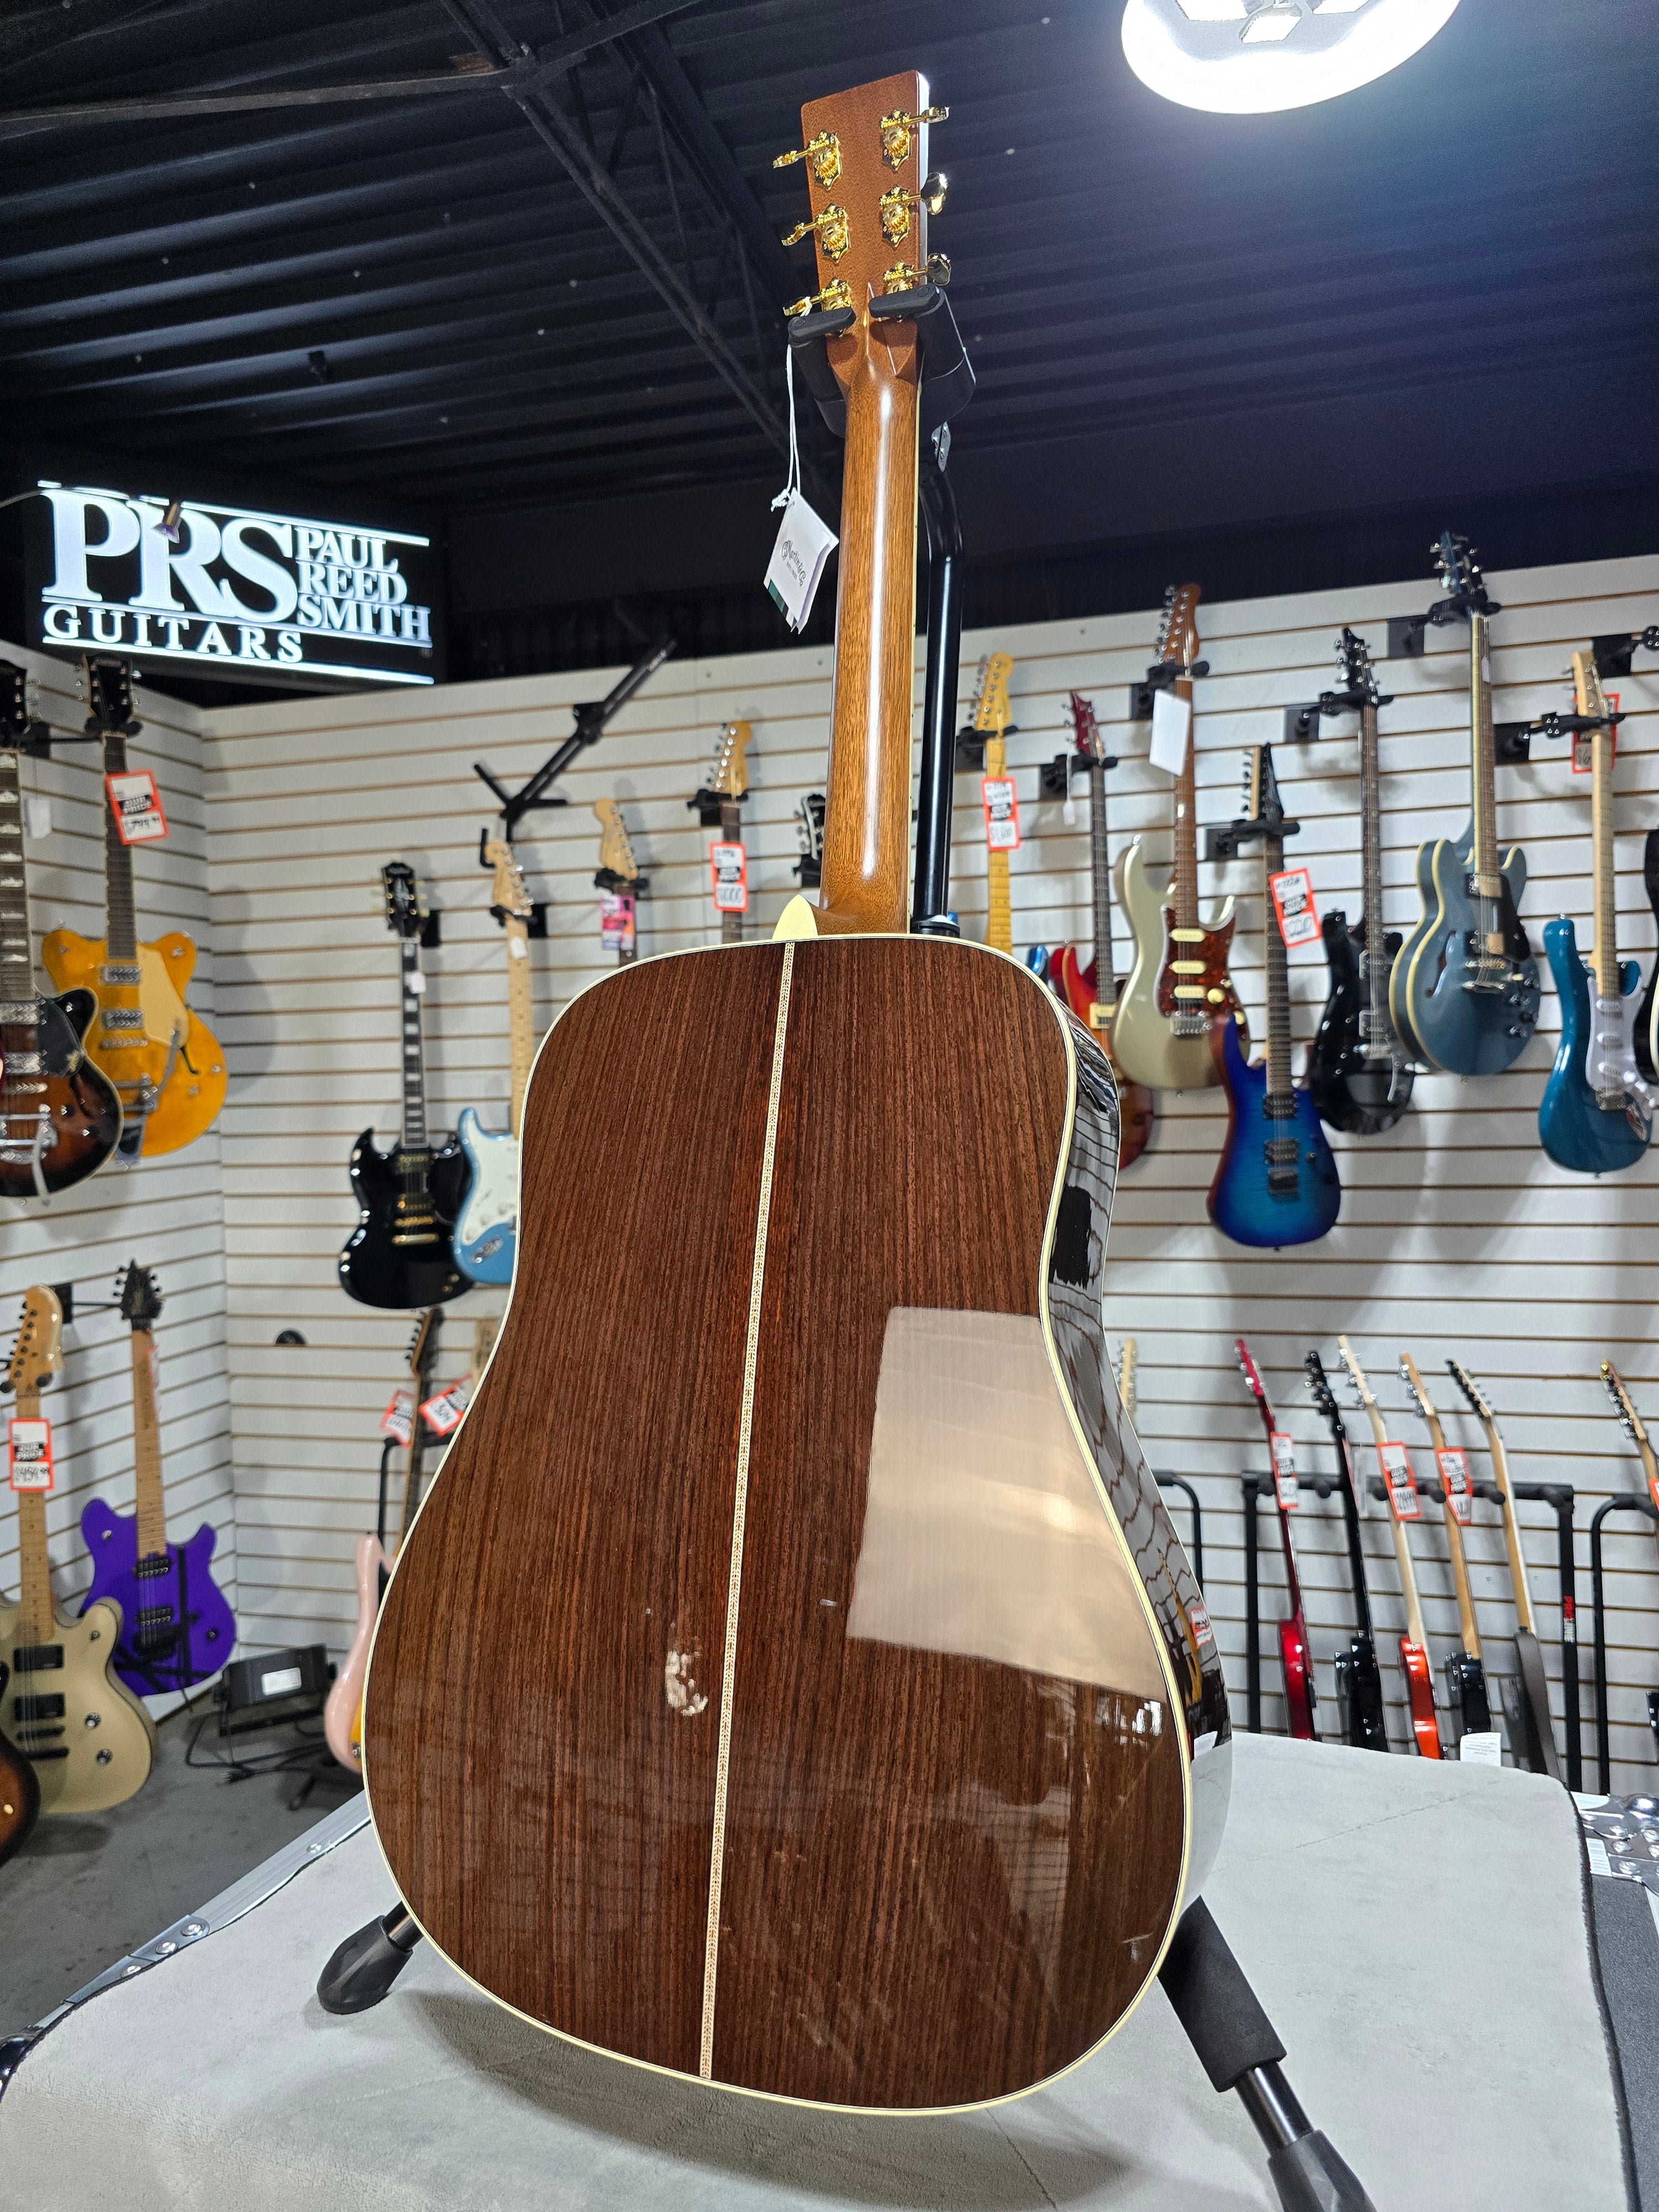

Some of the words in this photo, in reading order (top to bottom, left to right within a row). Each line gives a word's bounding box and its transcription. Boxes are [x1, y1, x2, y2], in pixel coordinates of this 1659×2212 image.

[39, 489, 298, 623] PRS
[295, 526, 398, 573] PAUL
[296, 560, 408, 606] REED
[43, 604, 303, 664] GUITARS
[296, 594, 431, 641] SMITH
